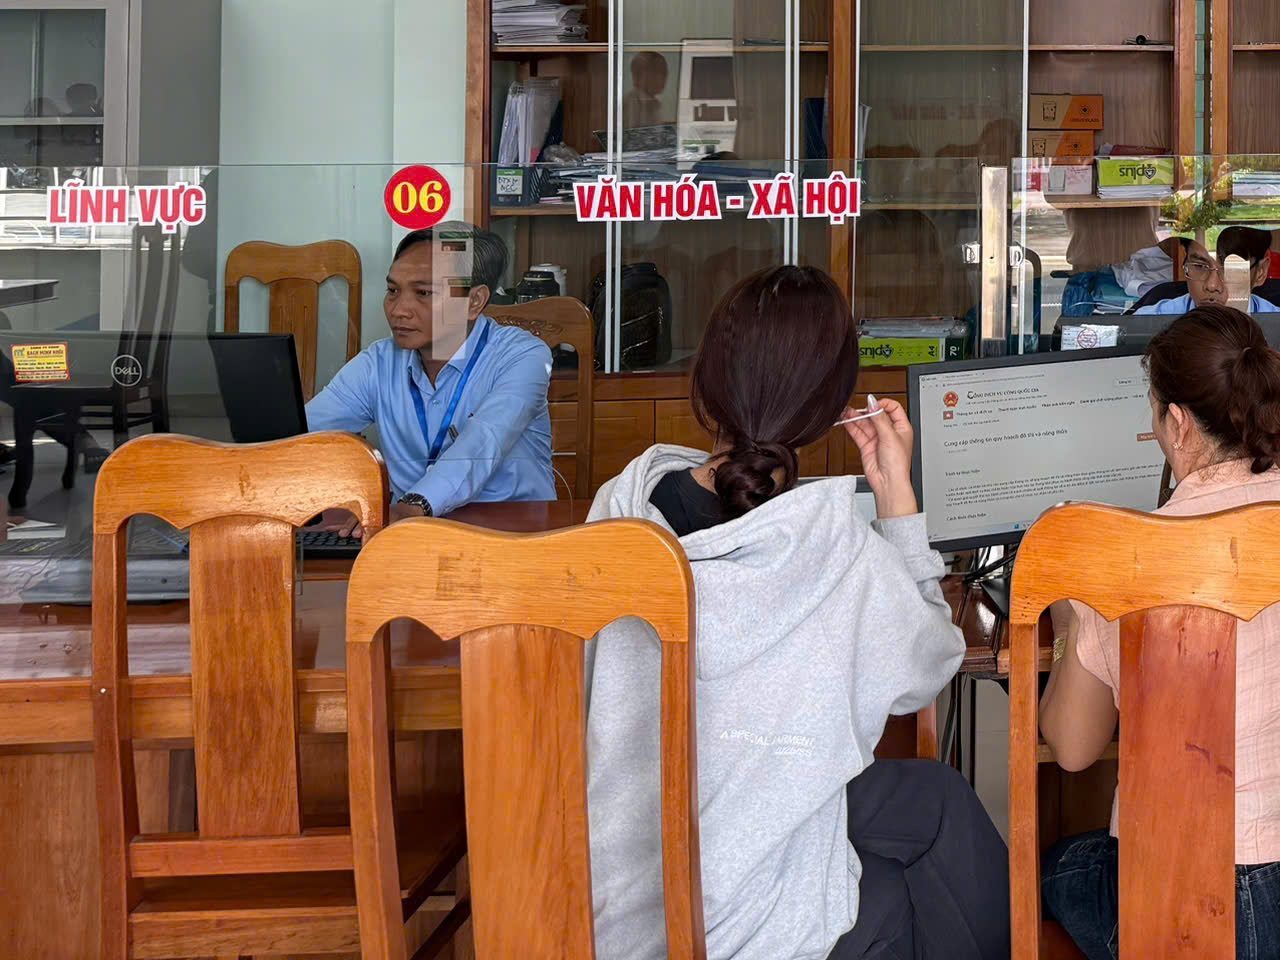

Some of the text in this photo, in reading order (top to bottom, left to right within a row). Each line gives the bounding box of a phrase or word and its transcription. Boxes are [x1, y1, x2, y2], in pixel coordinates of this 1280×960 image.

[49, 181, 204, 231] LĨNH VỰC
[392, 180, 444, 214] 06
[576, 177, 642, 219] VĂN
[652, 176, 720, 218] HÓA
[751, 175, 795, 216] XÃ
[805, 174, 858, 222] HỘI
[115, 366, 140, 375] DELL
